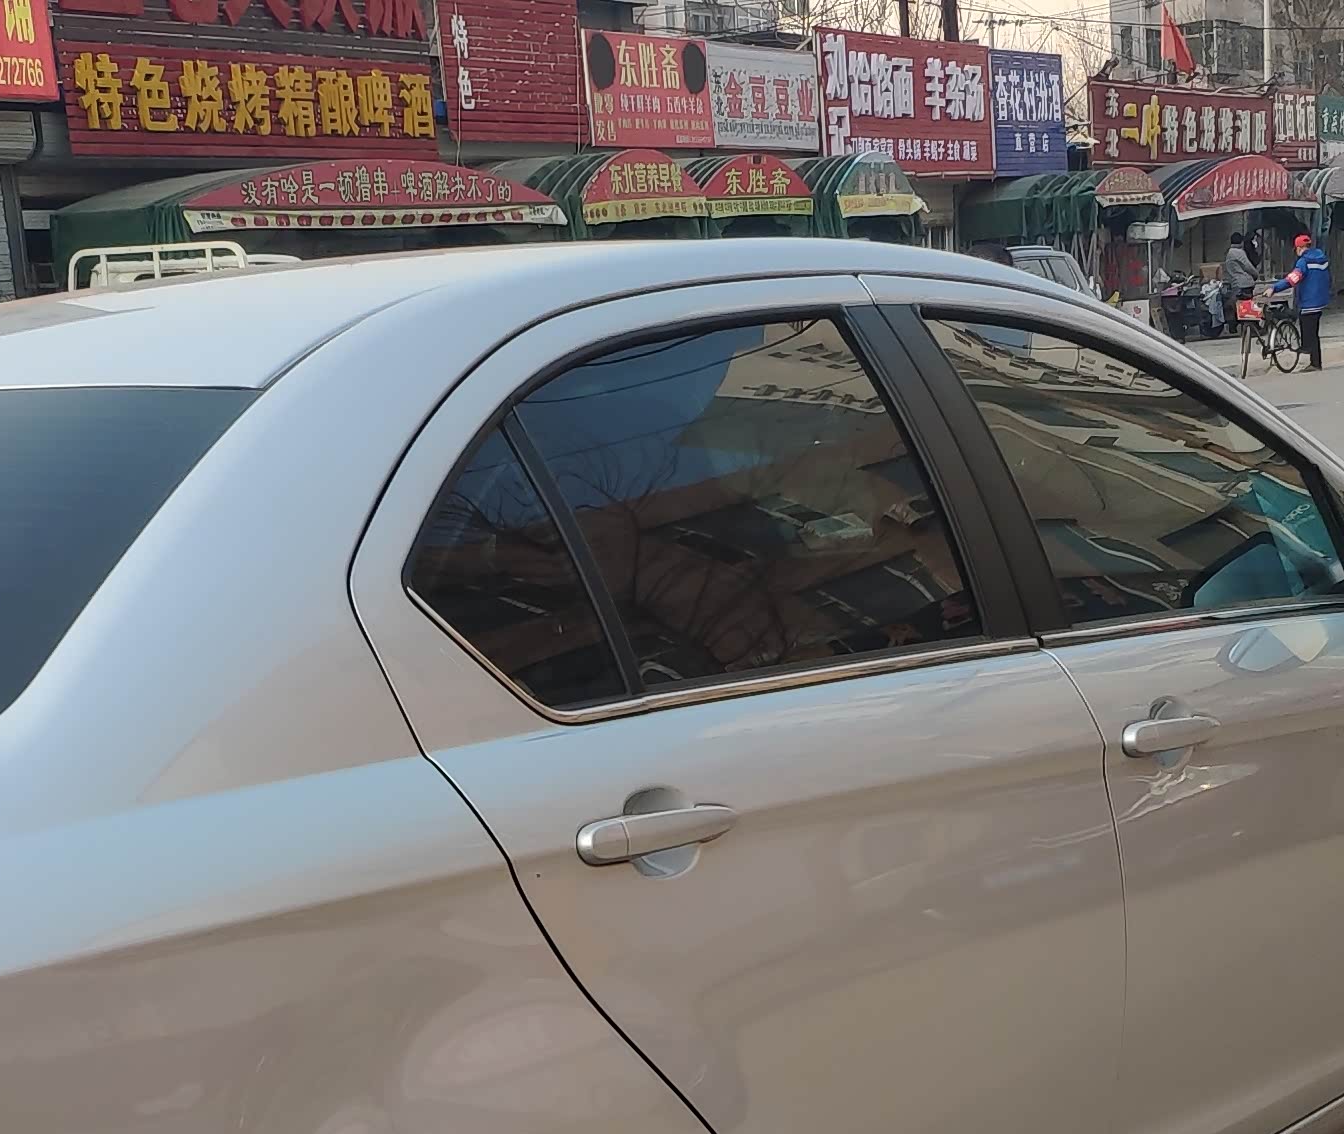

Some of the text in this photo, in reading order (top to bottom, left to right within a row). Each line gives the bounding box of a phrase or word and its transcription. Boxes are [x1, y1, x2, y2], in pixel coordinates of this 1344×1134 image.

[451, 14, 475, 110] 特色
[616, 40, 681, 90] 东胜斋
[924, 57, 985, 122] 羊杂汤
[74, 52, 437, 139] 特色烧烤精酿啤酒
[994, 68, 1062, 122] 杏花村汾酒
[722, 167, 792, 196] 东胜斋
